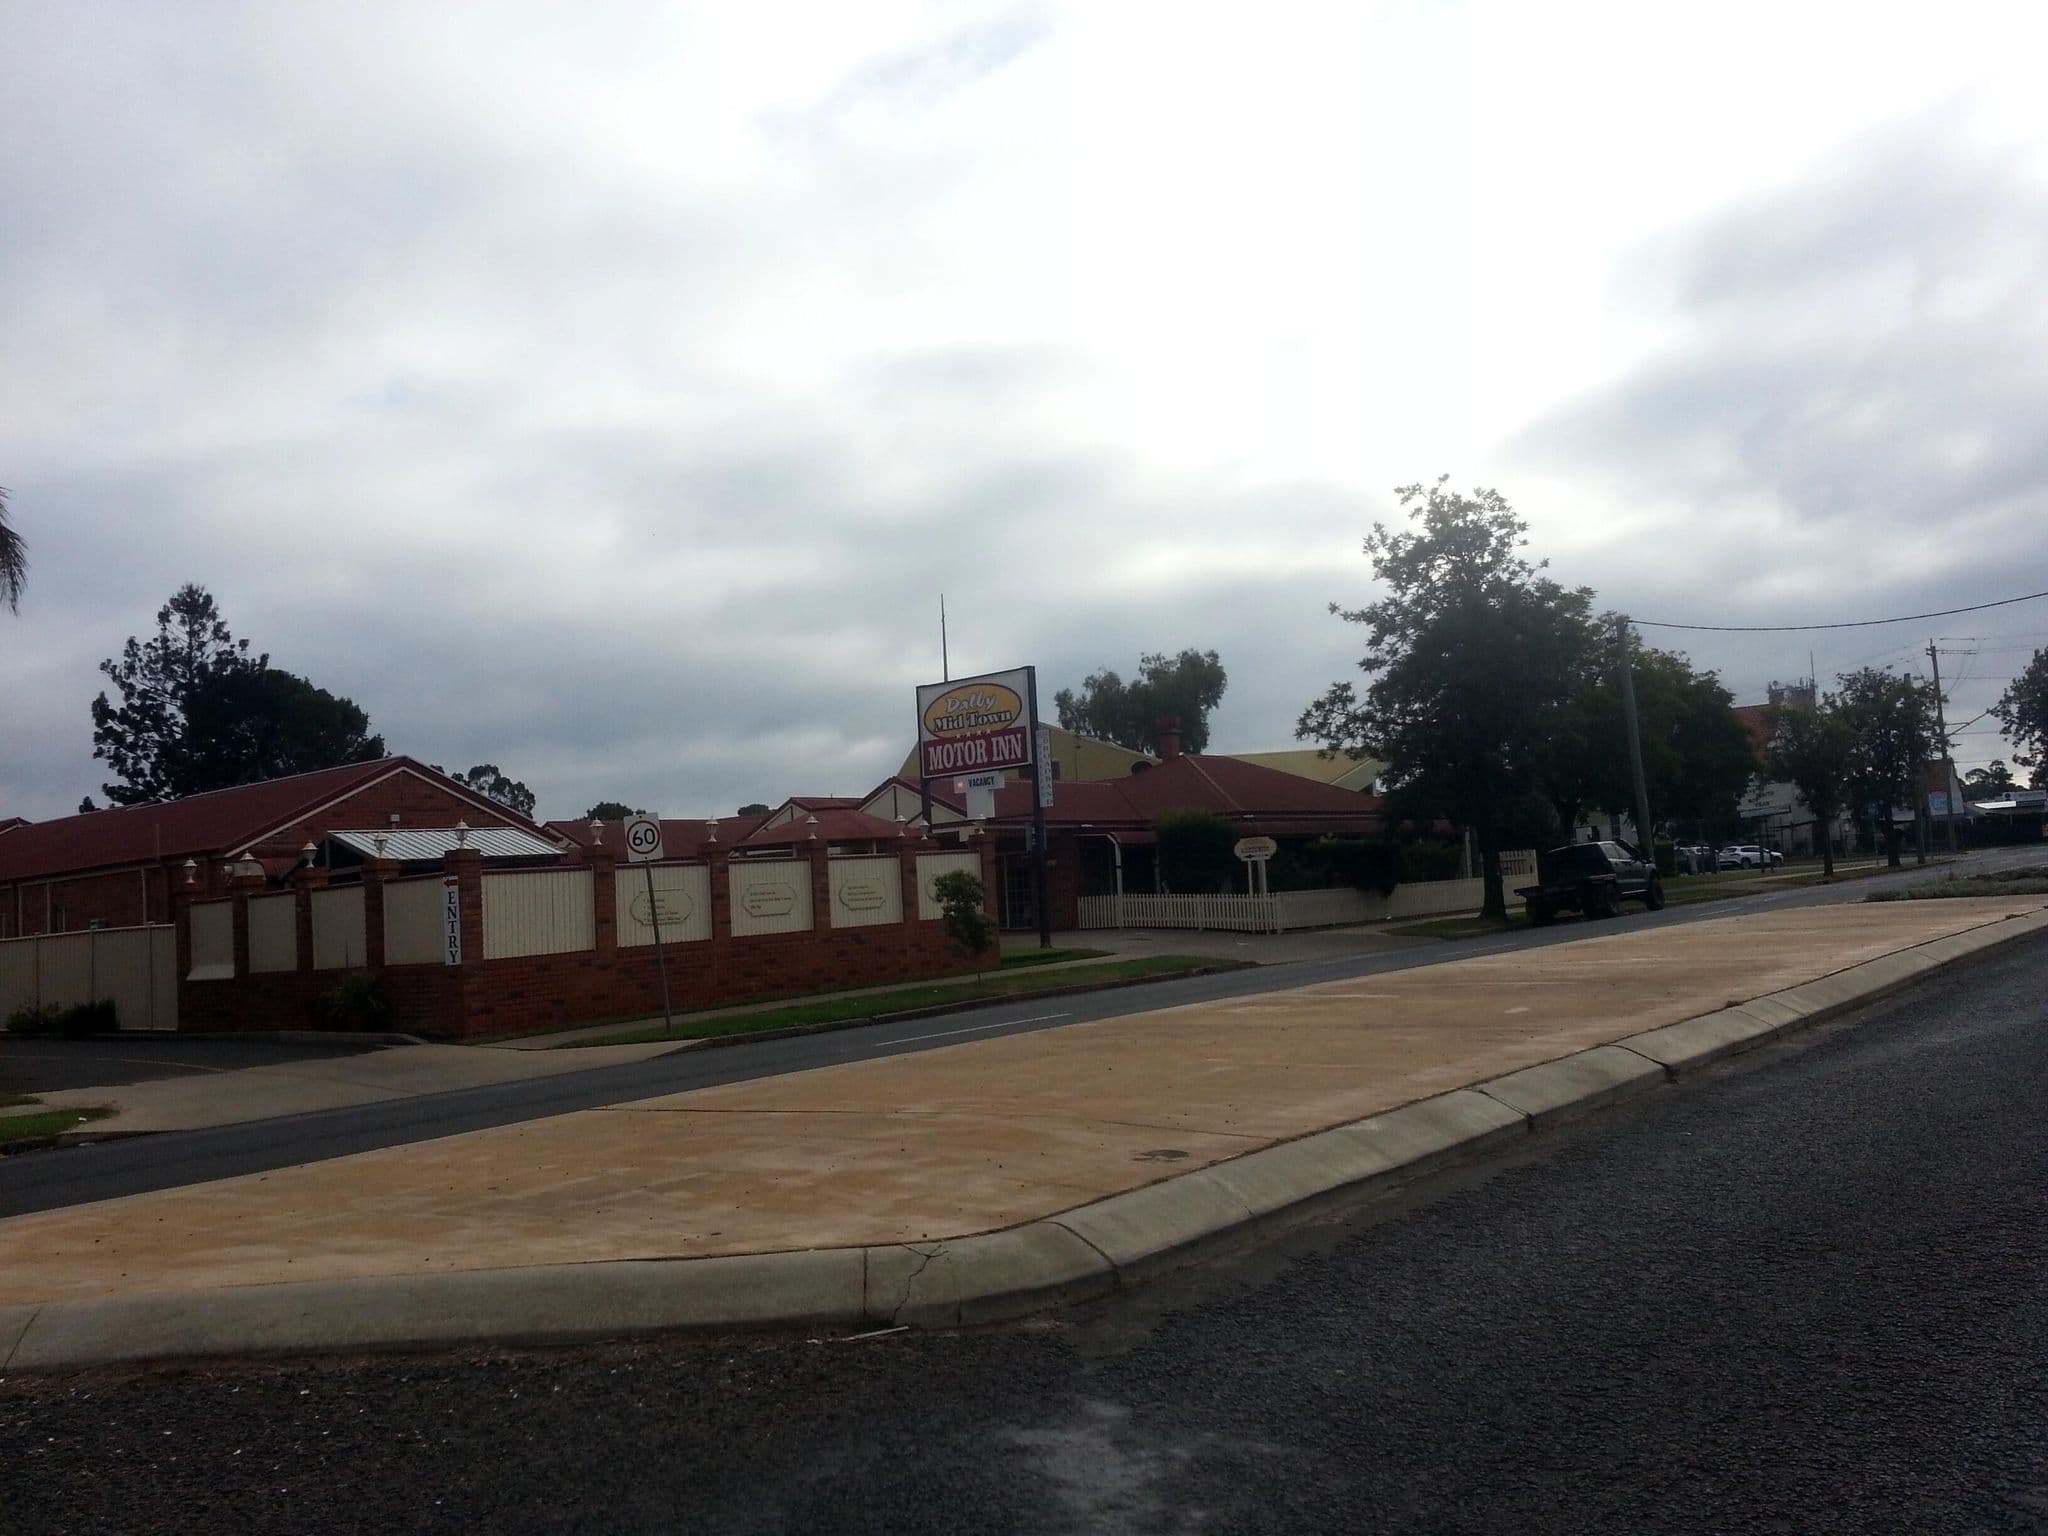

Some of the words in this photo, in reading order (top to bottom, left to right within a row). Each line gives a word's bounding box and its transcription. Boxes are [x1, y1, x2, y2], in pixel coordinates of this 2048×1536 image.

[947, 693, 995, 712] Dalby
[934, 715, 965, 732] Mid
[968, 711, 1011, 727] Town
[928, 740, 987, 771] MOTOR
[991, 734, 1022, 762] INN
[968, 776, 995, 788] VACANCY
[633, 828, 655, 846] 60
[447, 891, 458, 963] ENTRY
